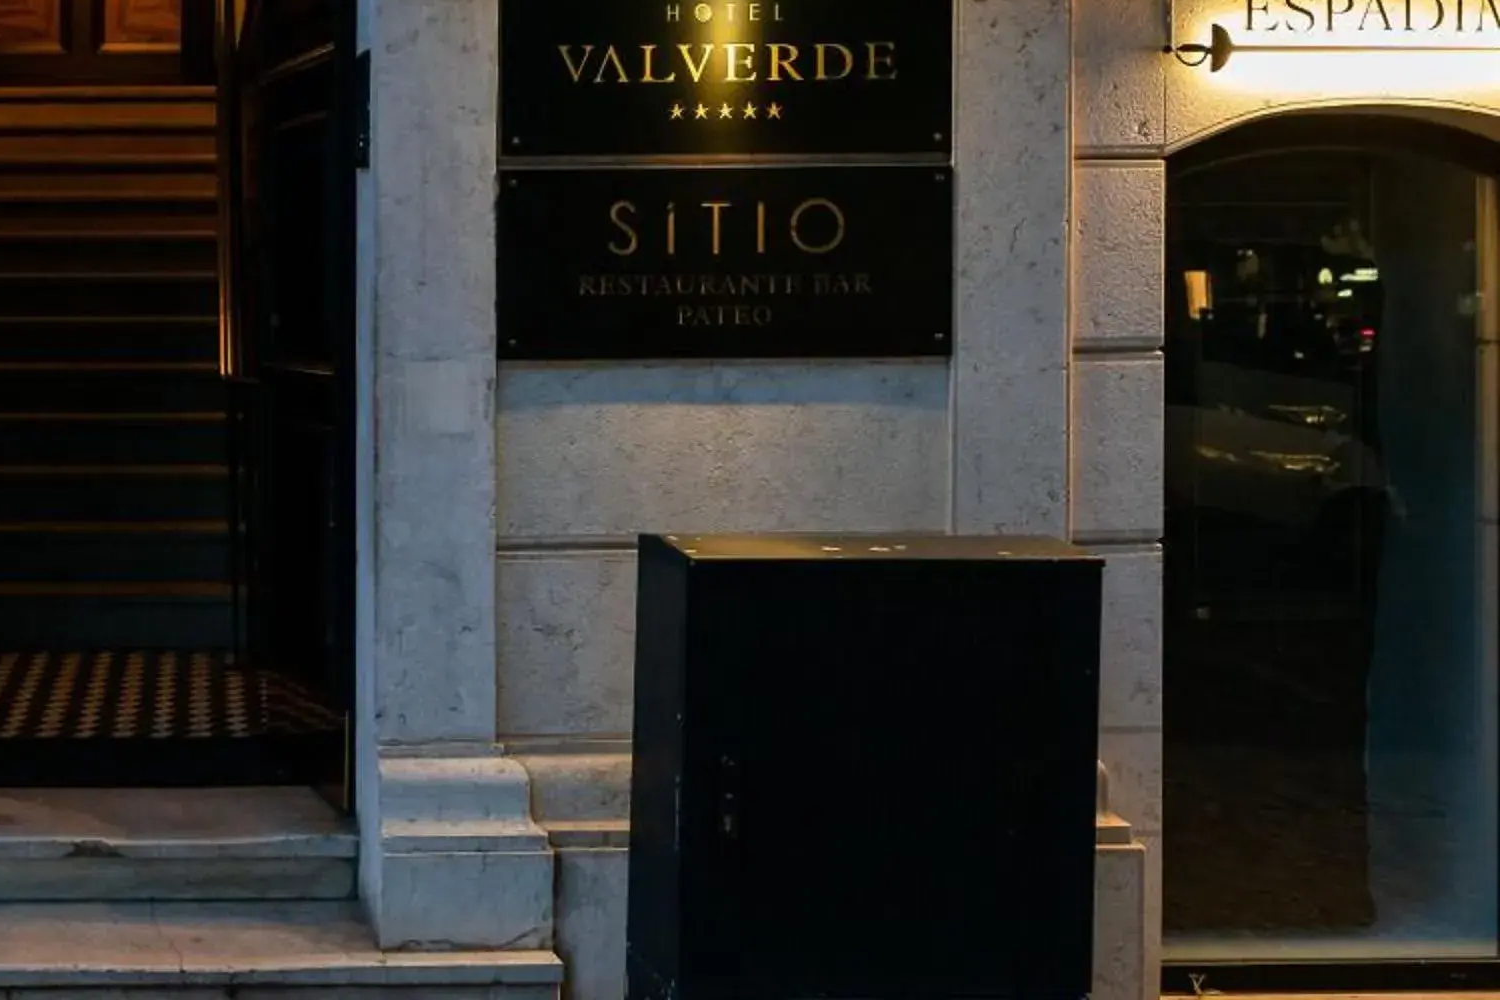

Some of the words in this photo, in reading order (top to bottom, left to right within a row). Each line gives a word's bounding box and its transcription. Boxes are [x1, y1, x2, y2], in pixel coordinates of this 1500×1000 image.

[667, 3, 784, 22] HOTEL
[557, 42, 899, 83] VALVERDE
[578, 272, 802, 297] RESTAURANTE
[813, 272, 873, 295] BAR
[676, 304, 772, 326] PATEO
